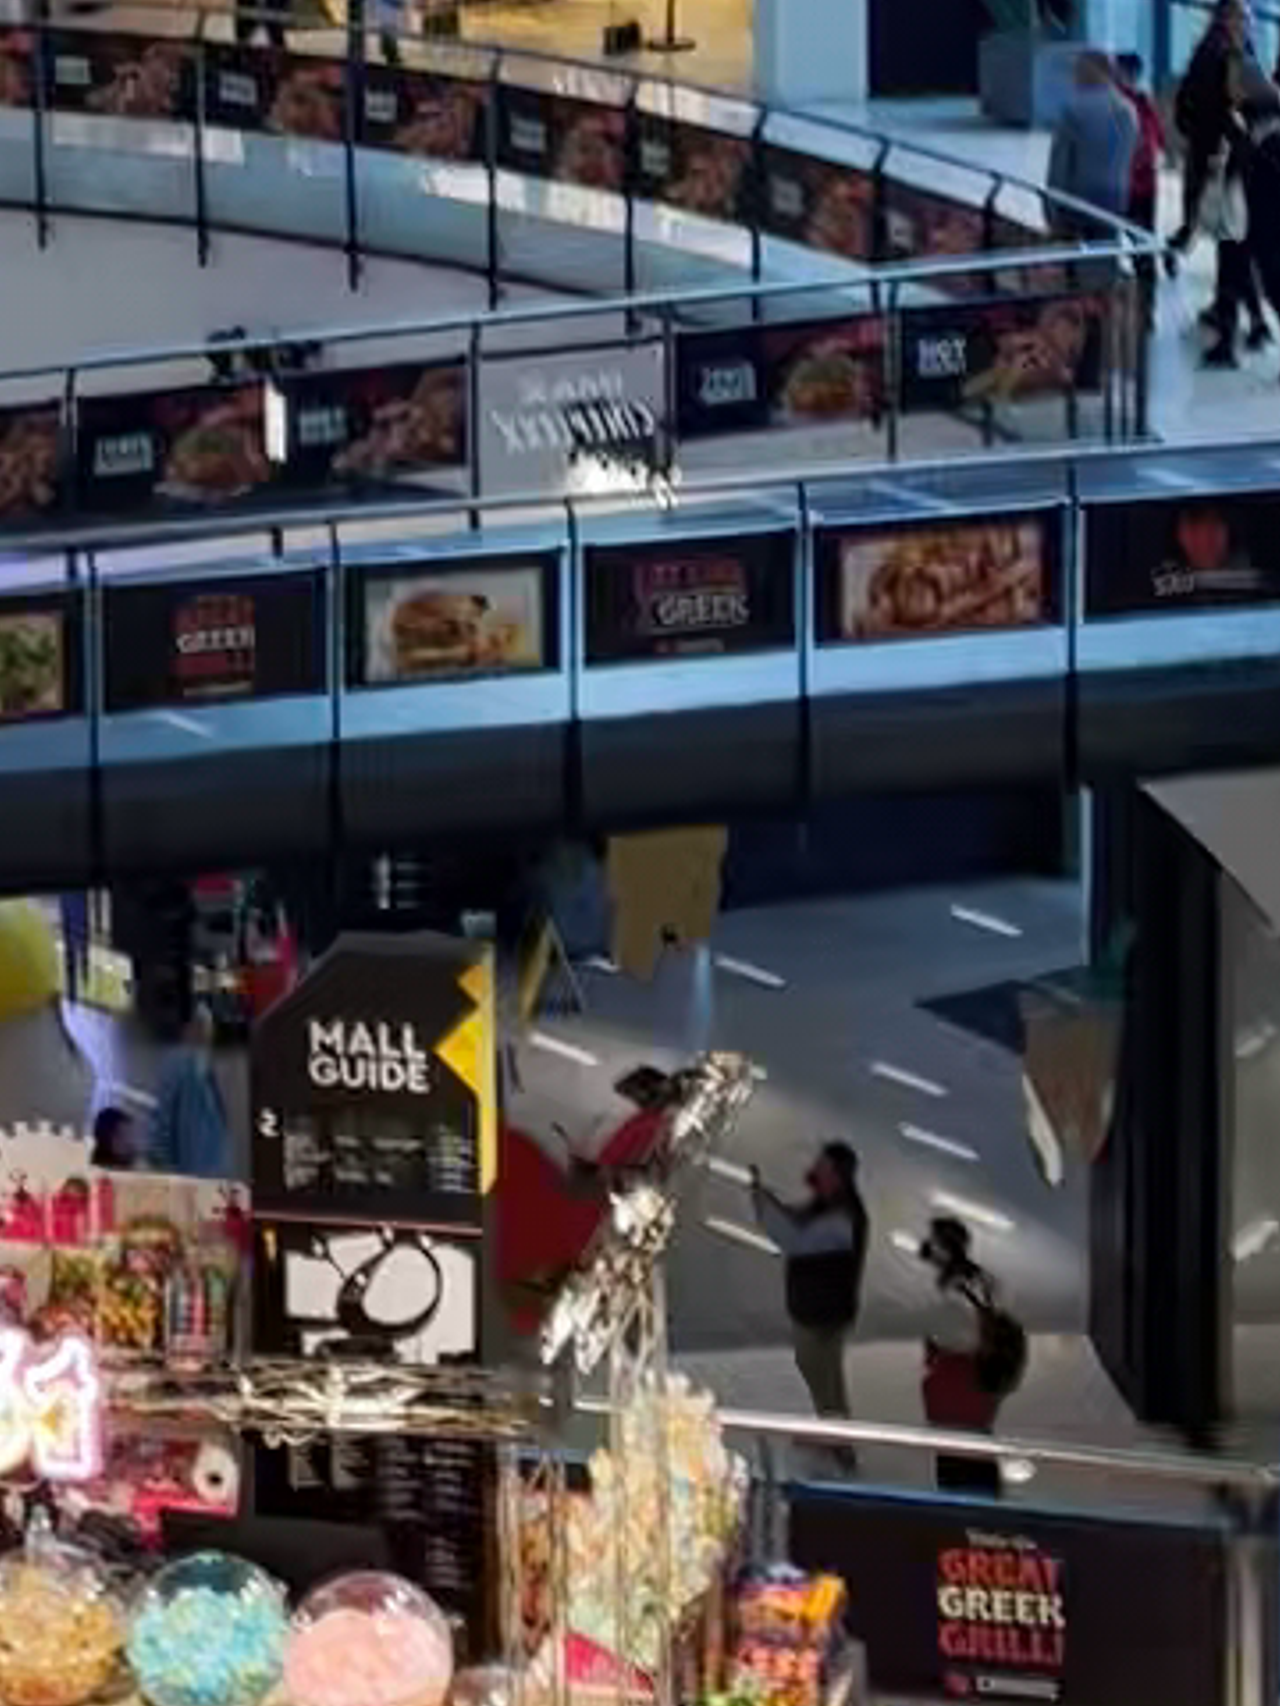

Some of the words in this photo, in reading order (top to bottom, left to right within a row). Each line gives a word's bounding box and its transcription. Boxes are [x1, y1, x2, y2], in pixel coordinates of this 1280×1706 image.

[308, 1020, 426, 1060] MALL
[309, 1054, 429, 1093] GUIDE
[939, 1548, 1066, 1587] GREAT
[937, 1584, 1066, 1628] GREEK
